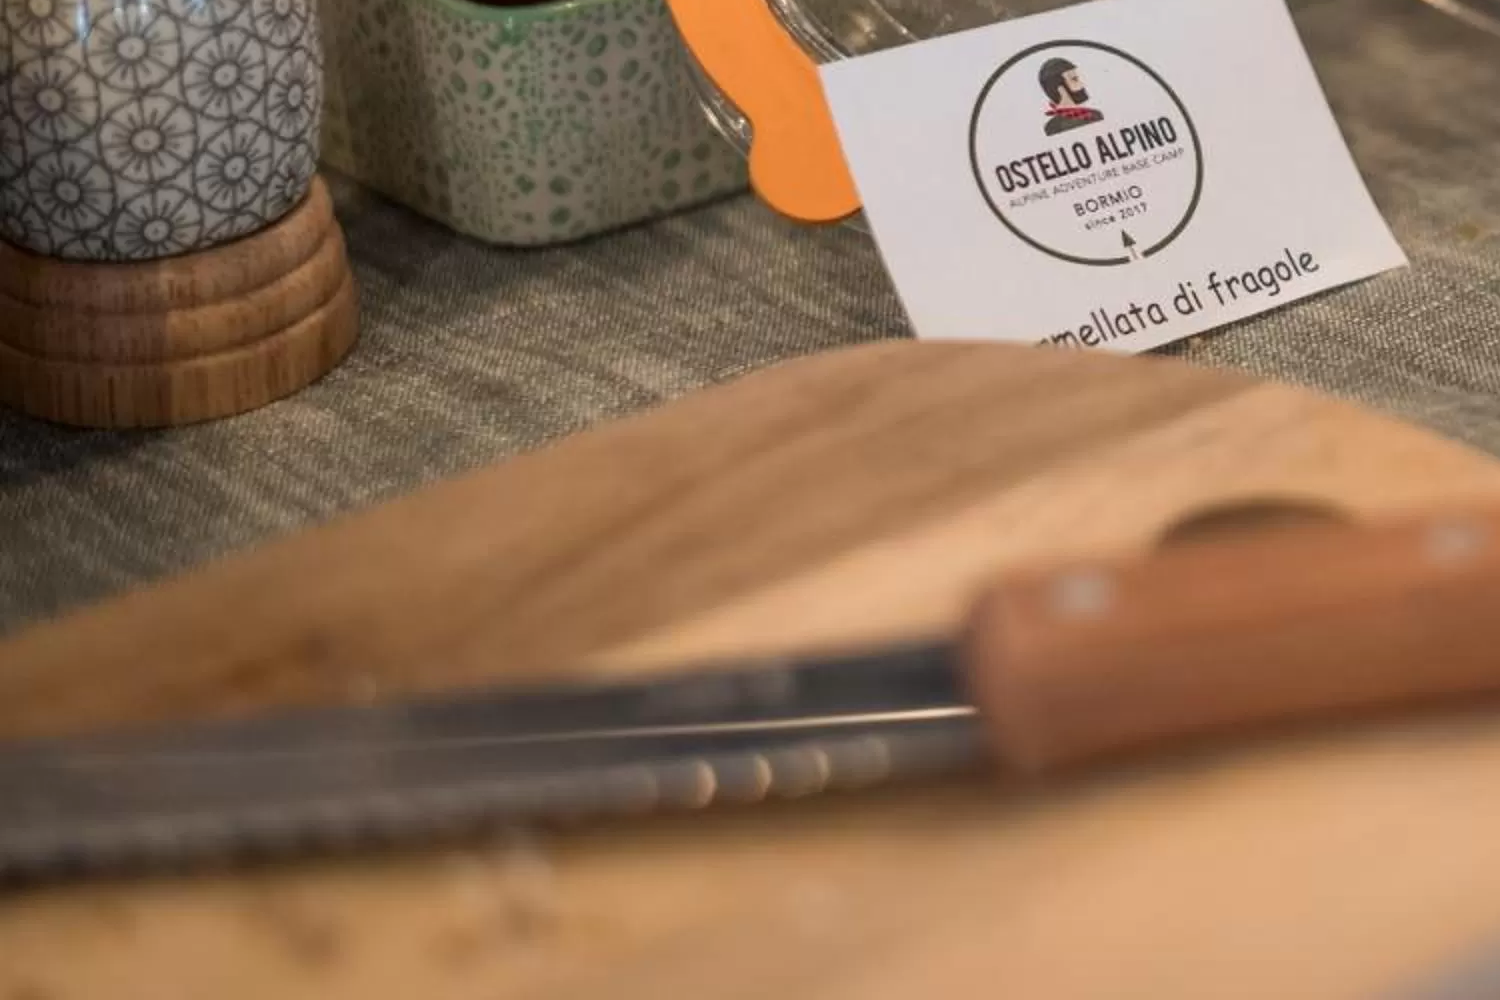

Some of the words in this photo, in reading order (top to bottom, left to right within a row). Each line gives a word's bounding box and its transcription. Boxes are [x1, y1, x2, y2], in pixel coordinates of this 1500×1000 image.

[995, 142, 1092, 193] OSTELLO
[1095, 116, 1177, 165] ALPINO
[1009, 189, 1051, 208] ALPINE
[1053, 170, 1120, 196] ADVENTURE
[1122, 158, 1152, 175] BASE
[1152, 147, 1185, 165] CAMP
[1072, 185, 1143, 217] BORMIO
[1084, 214, 1117, 231] since
[1119, 202, 1148, 221] 2017
[1173, 281, 1203, 316] di
[1207, 247, 1320, 307] fragole
